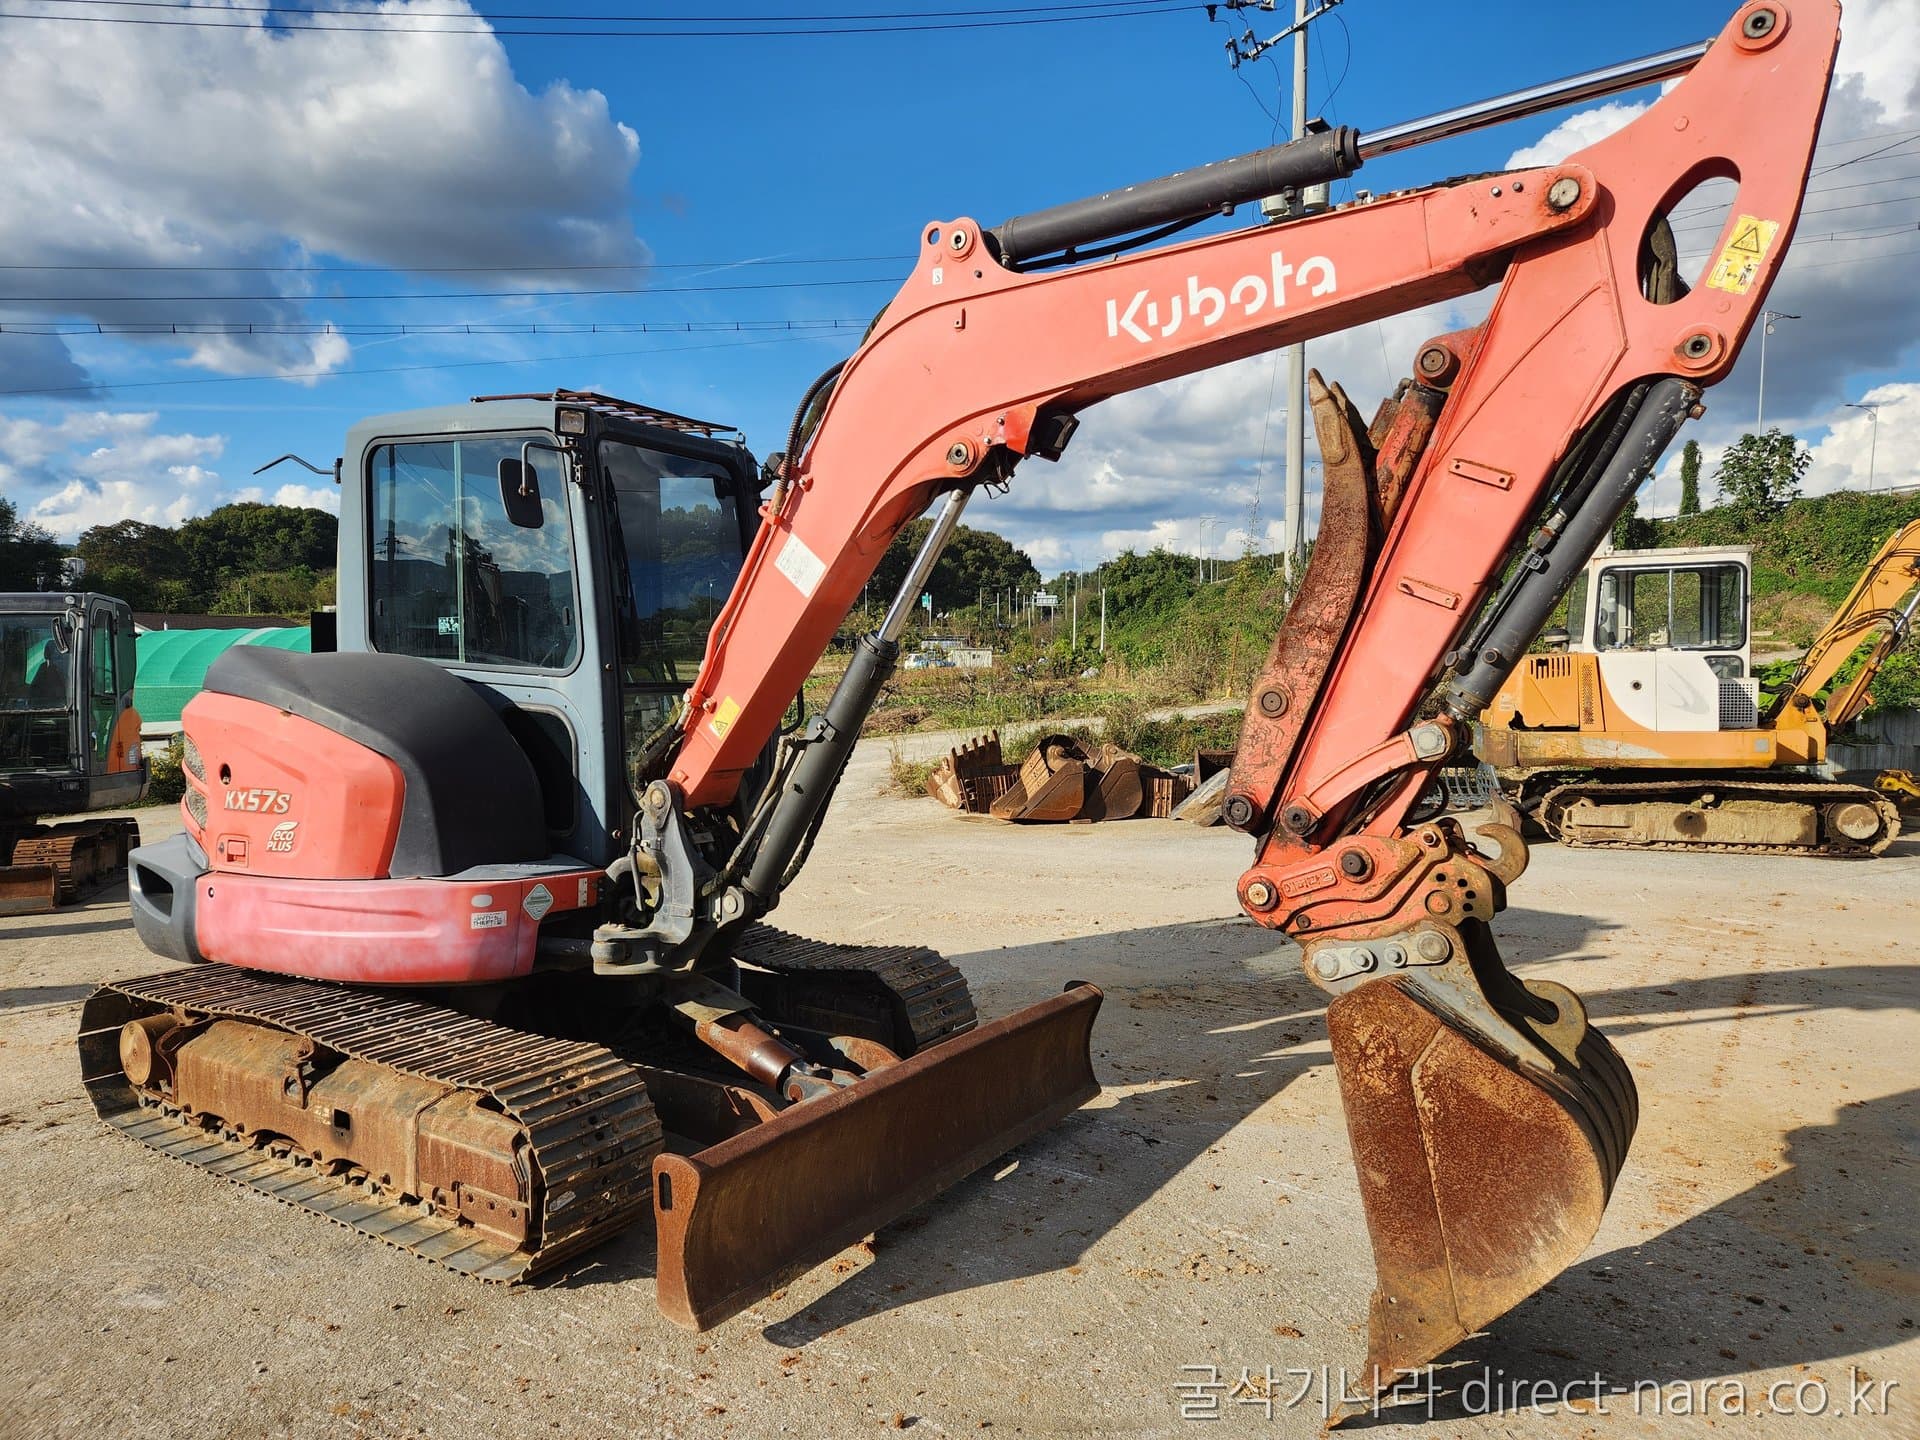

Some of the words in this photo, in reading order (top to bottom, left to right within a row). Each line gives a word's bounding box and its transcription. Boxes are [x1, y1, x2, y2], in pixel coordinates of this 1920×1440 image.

[1106, 251, 1337, 343] Kubota
[224, 789, 291, 814] KX57S
[273, 830, 294, 841] eco
[267, 841, 292, 851] PLUS
